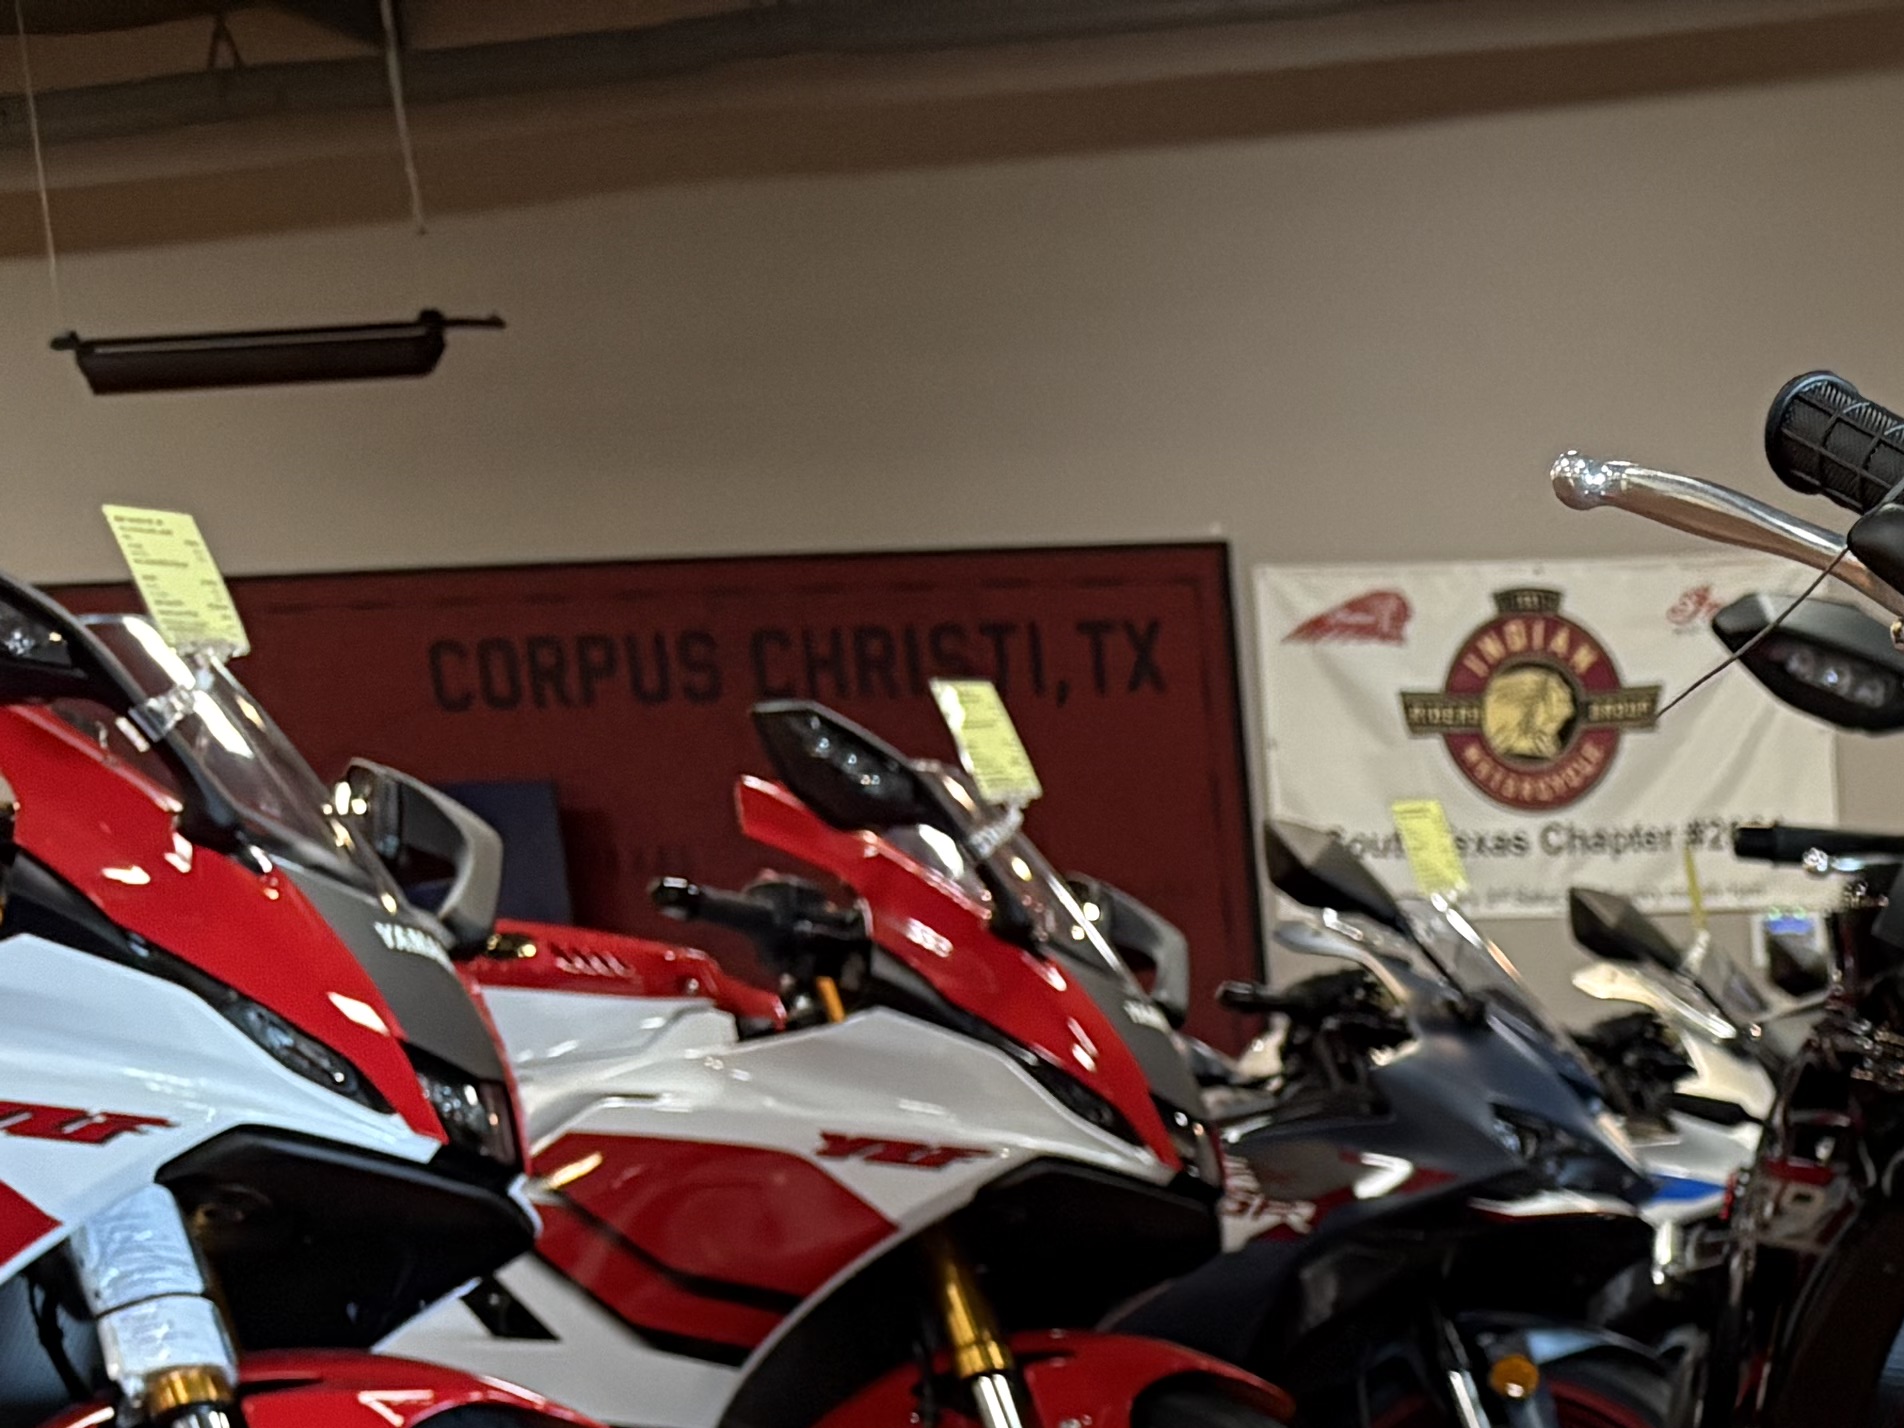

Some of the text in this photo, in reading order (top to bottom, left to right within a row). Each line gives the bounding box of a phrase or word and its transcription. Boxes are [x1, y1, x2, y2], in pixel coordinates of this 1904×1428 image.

[429, 631, 723, 712] CORPUS
[1461, 617, 1600, 679] INDIAN
[1541, 821, 1673, 860] Chapter
